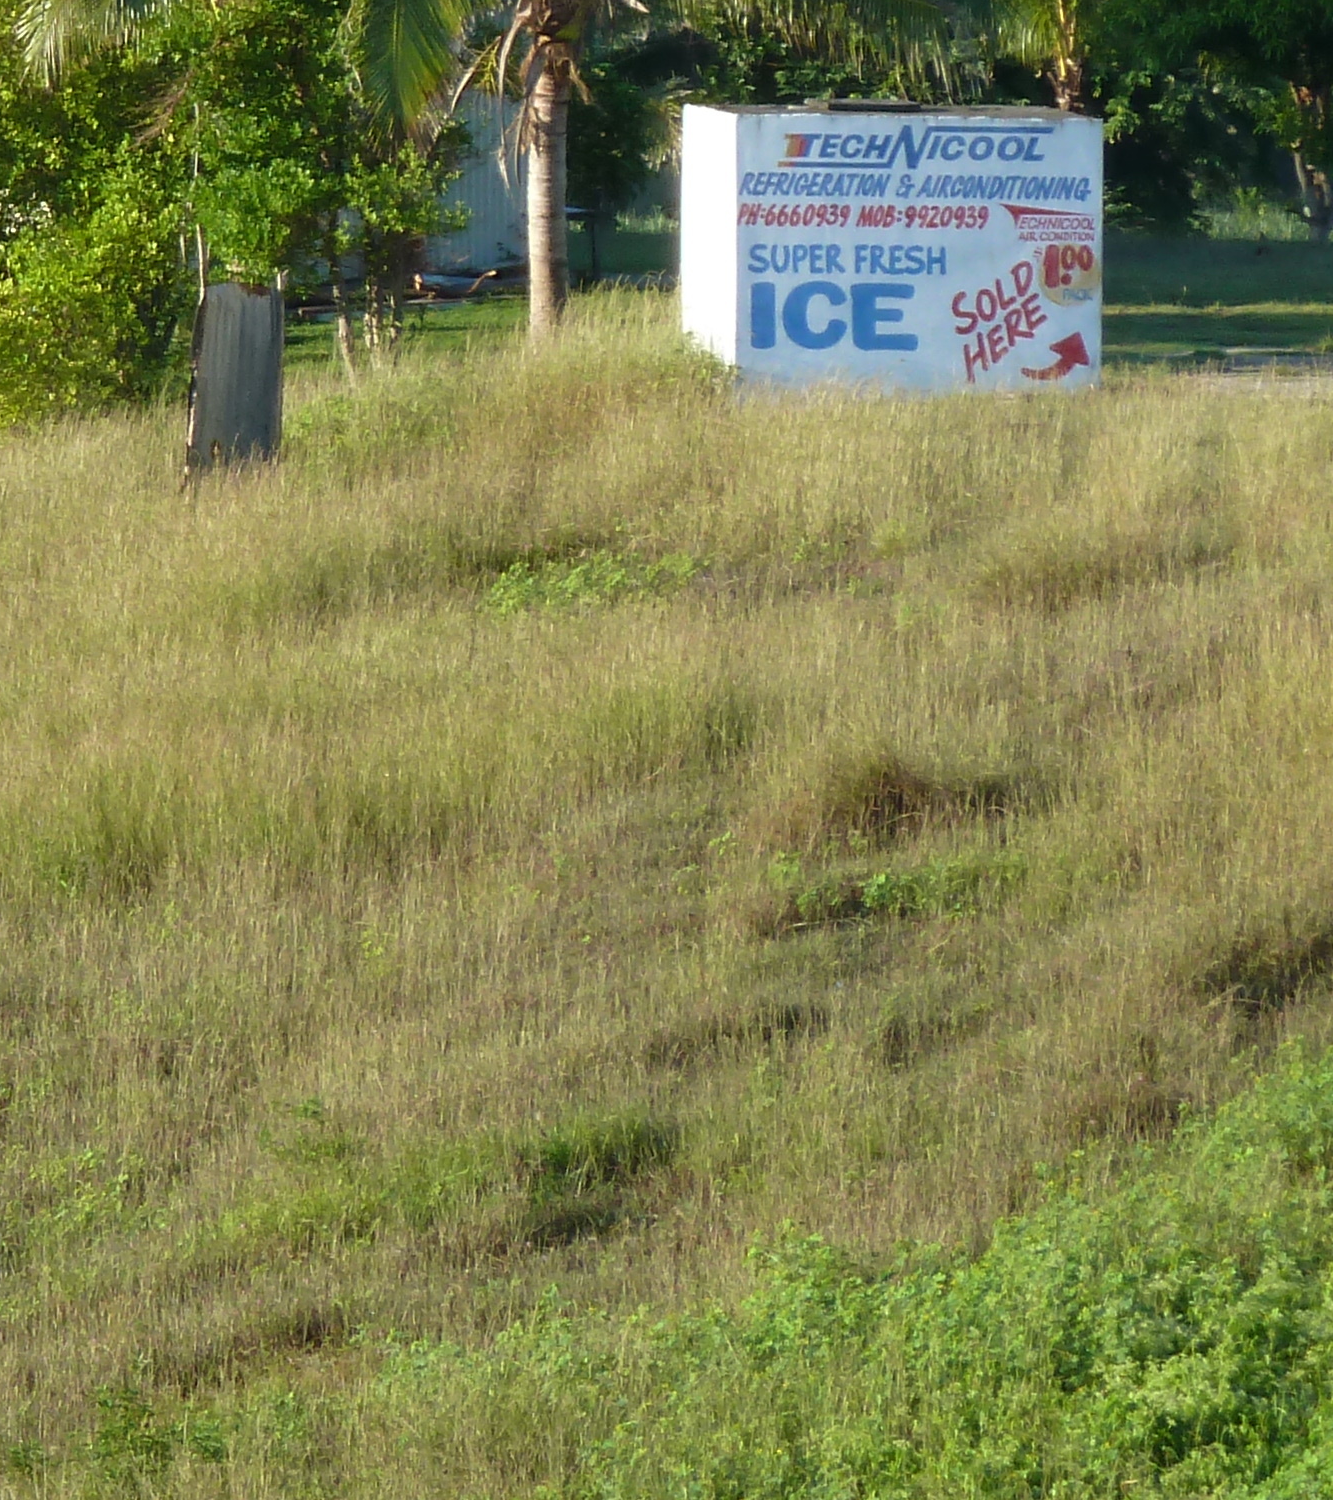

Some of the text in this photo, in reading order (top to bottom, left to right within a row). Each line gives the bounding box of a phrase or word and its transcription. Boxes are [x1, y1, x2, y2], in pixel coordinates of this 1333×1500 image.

[780, 125, 1052, 169] TECHNICOOL
[739, 172, 1093, 201] REFRIGERATION & AIRCONDITIONING
[737, 203, 989, 229] PH:6660939 MOB:9920939
[1039, 232, 1095, 242] CONDITION
[748, 244, 947, 276] SUPER FRESH
[750, 281, 919, 351] ICE
[952, 261, 1033, 335] SOLD
[963, 293, 1047, 384] HERE
